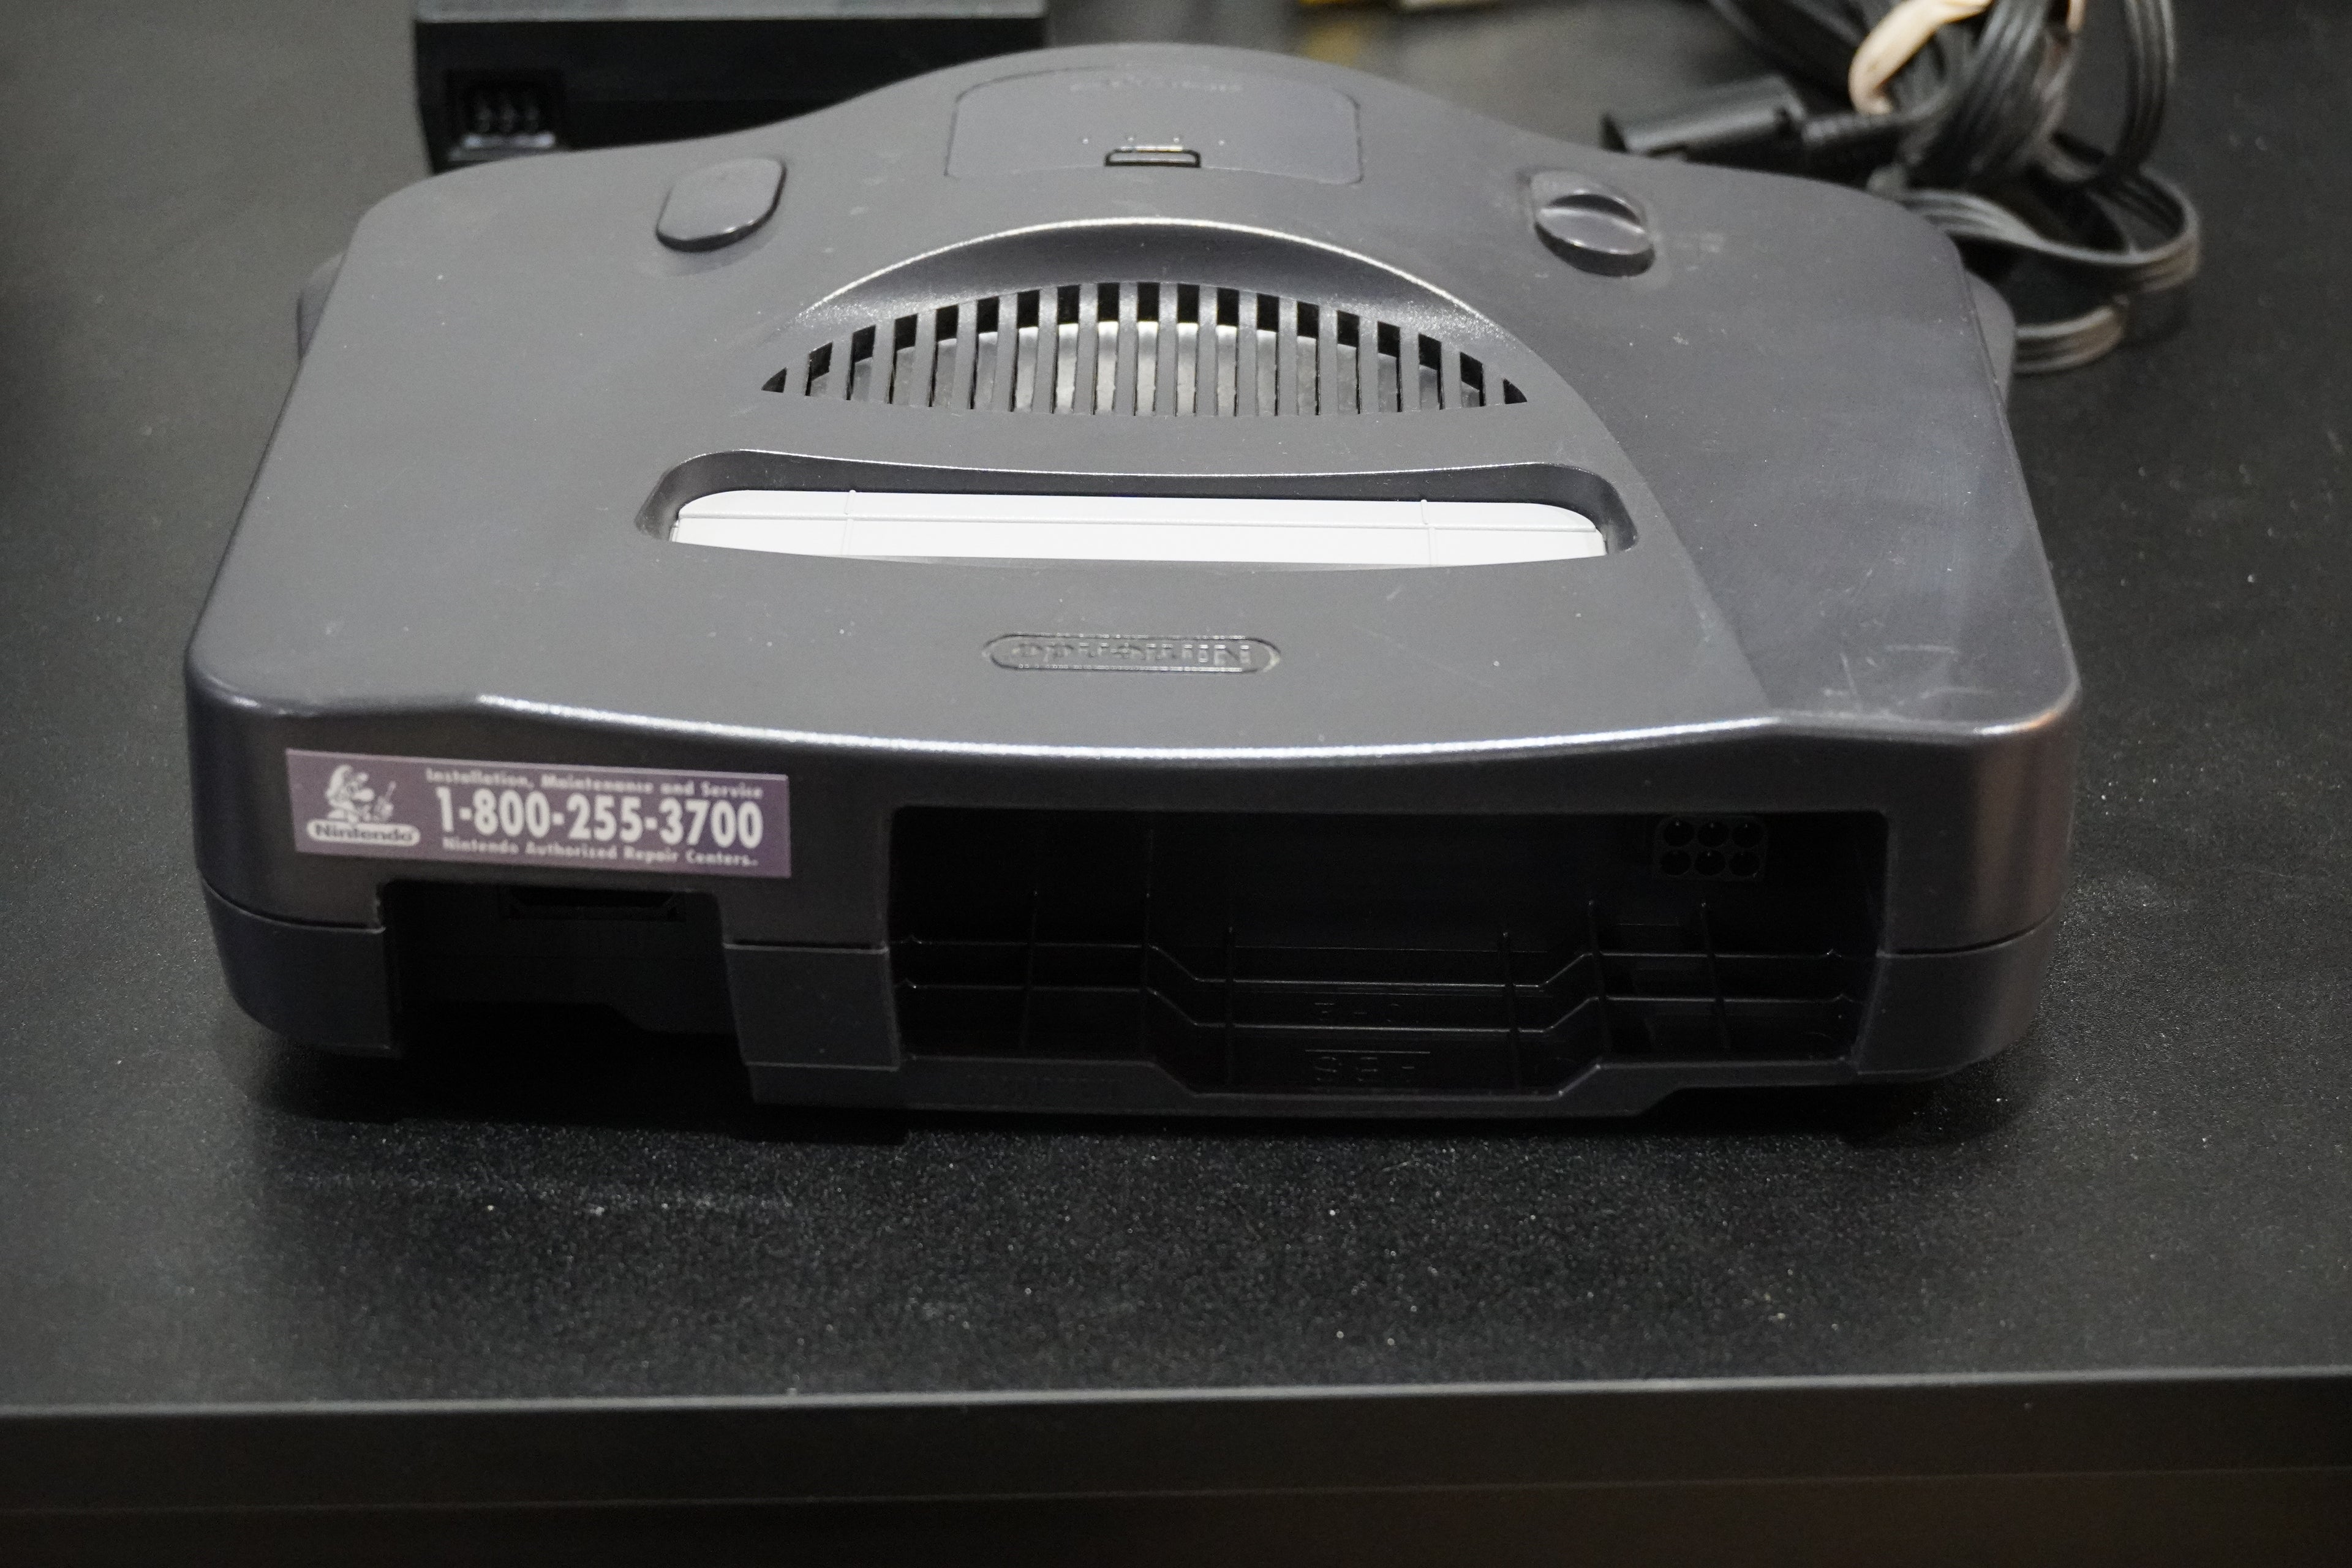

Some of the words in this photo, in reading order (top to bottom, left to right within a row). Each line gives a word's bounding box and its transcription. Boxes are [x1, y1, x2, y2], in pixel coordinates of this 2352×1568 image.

[540, 772, 654, 794] Maintenance
[660, 779, 695, 796] and
[700, 780, 763, 798] Service
[435, 786, 763, 849] 1-800-255-3700
[315, 824, 414, 842] Nintendo
[442, 836, 519, 854] Nintendo
[525, 840, 617, 859] Authorized
[624, 845, 678, 864] Repair
